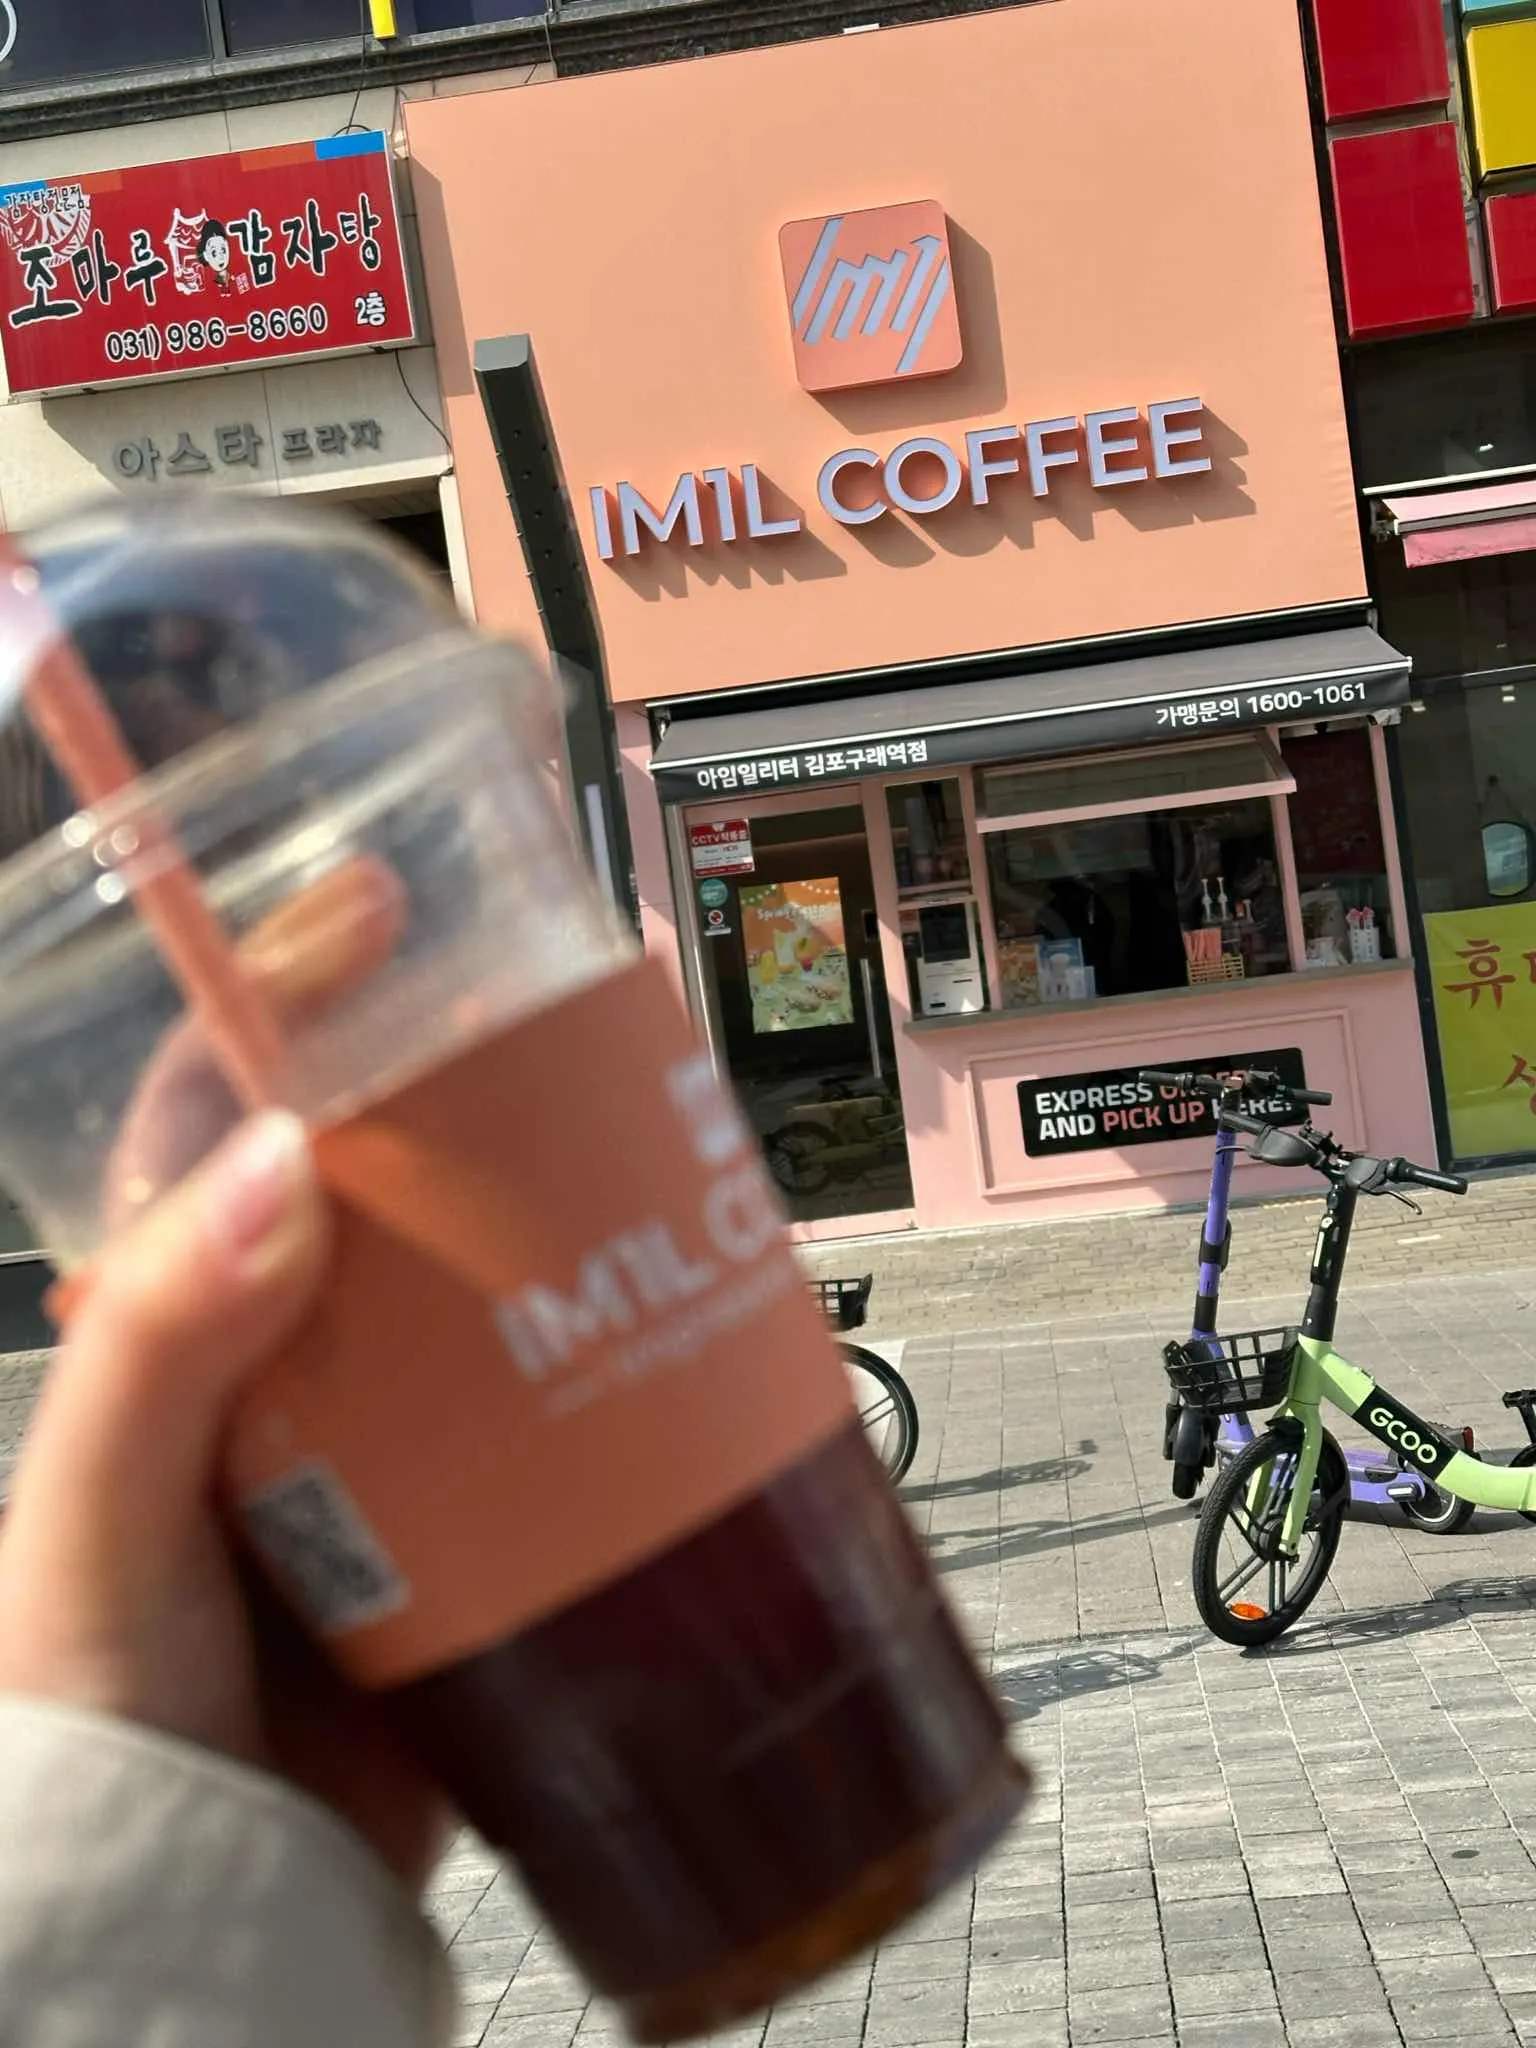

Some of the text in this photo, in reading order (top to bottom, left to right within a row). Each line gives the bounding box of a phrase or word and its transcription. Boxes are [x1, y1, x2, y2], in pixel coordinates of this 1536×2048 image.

[8, 193, 381, 329] 조마루 감자탕
[105, 303, 328, 363] 031) 986-8660
[354, 291, 387, 326] 2층
[113, 417, 382, 481] 아스타 프라자
[588, 395, 1212, 560] IM1L COFFEE
[1156, 682, 1366, 728] 가맹문의 1600-1061
[697, 739, 928, 791] 아임일리터 김포구래역점
[1442, 938, 1536, 1011] 휴
[1035, 1082, 1153, 1115] EXPRESS
[1039, 1115, 1096, 1141] AND
[1103, 1107, 1163, 1132] PICK
[1168, 1101, 1205, 1125] UP
[1369, 1407, 1437, 1464] GCOO
